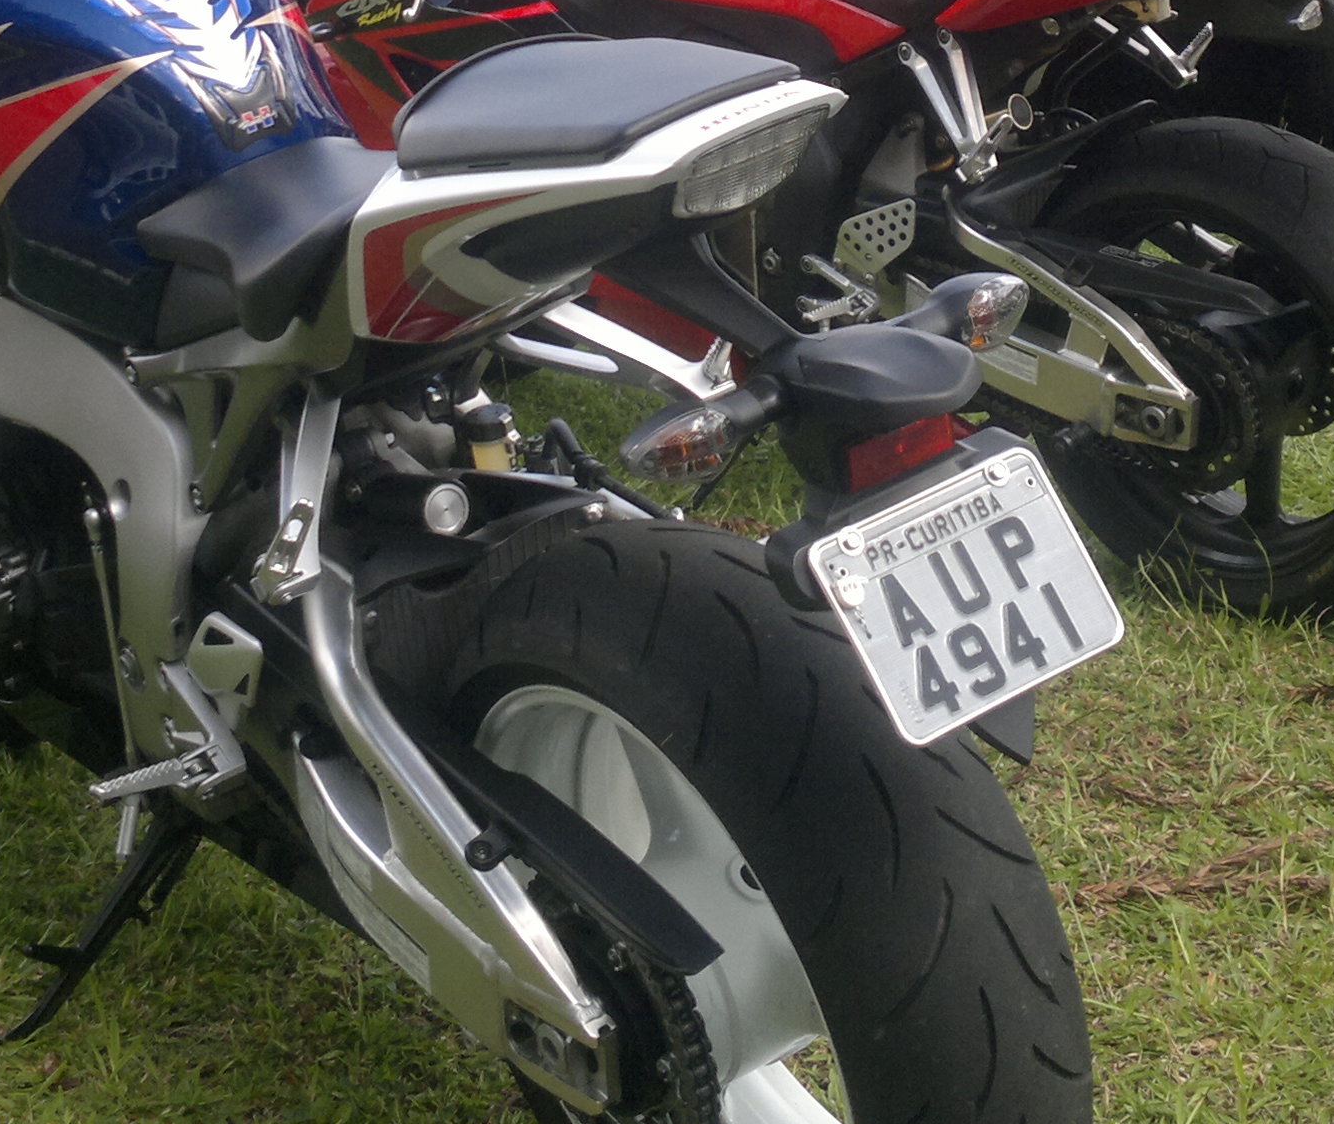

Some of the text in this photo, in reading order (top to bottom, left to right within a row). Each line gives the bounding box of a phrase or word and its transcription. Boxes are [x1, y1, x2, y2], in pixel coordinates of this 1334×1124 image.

[865, 491, 1004, 570] PR-CURITIBA
[879, 515, 1035, 648] AUP
[914, 582, 1085, 713] 4941
